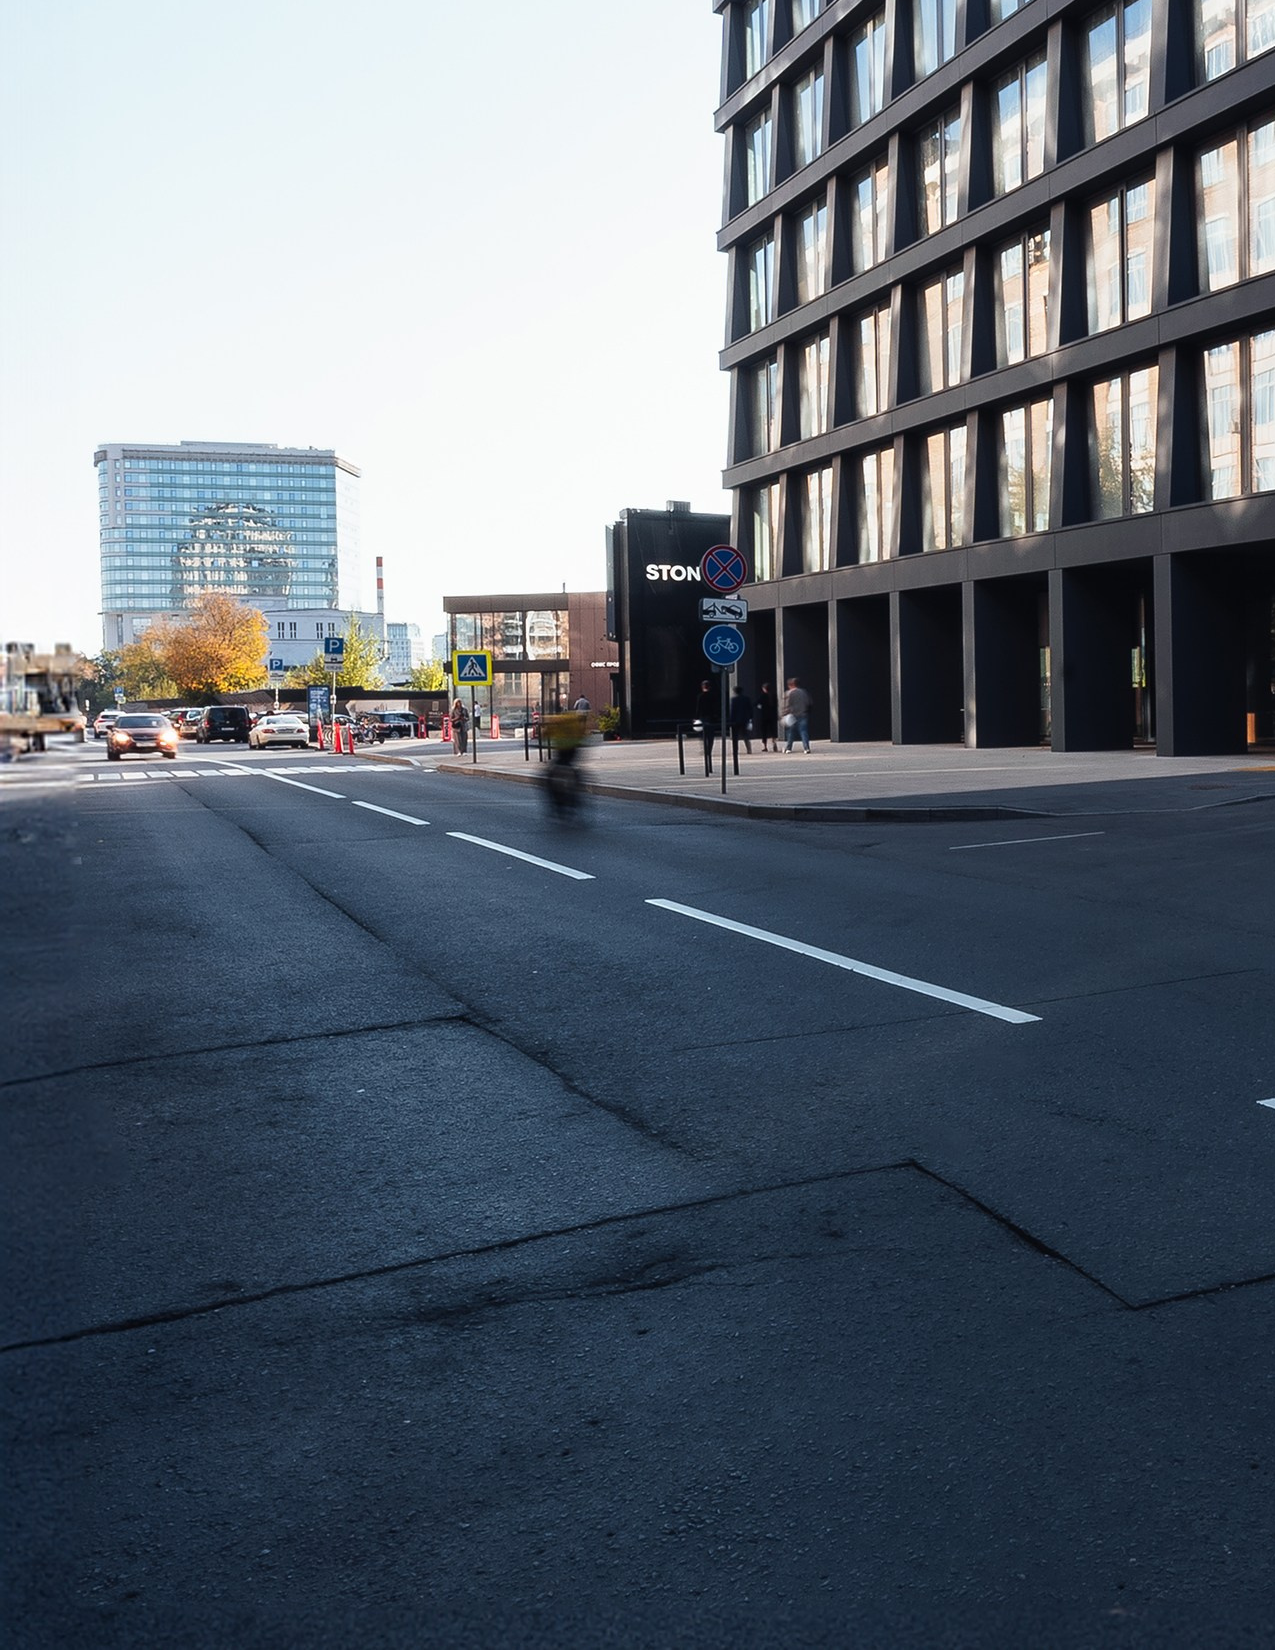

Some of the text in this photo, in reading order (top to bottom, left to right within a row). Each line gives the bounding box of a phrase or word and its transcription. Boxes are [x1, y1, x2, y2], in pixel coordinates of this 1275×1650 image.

[646, 564, 701, 581] STON
[329, 639, 339, 652] P
[272, 659, 281, 670] P
